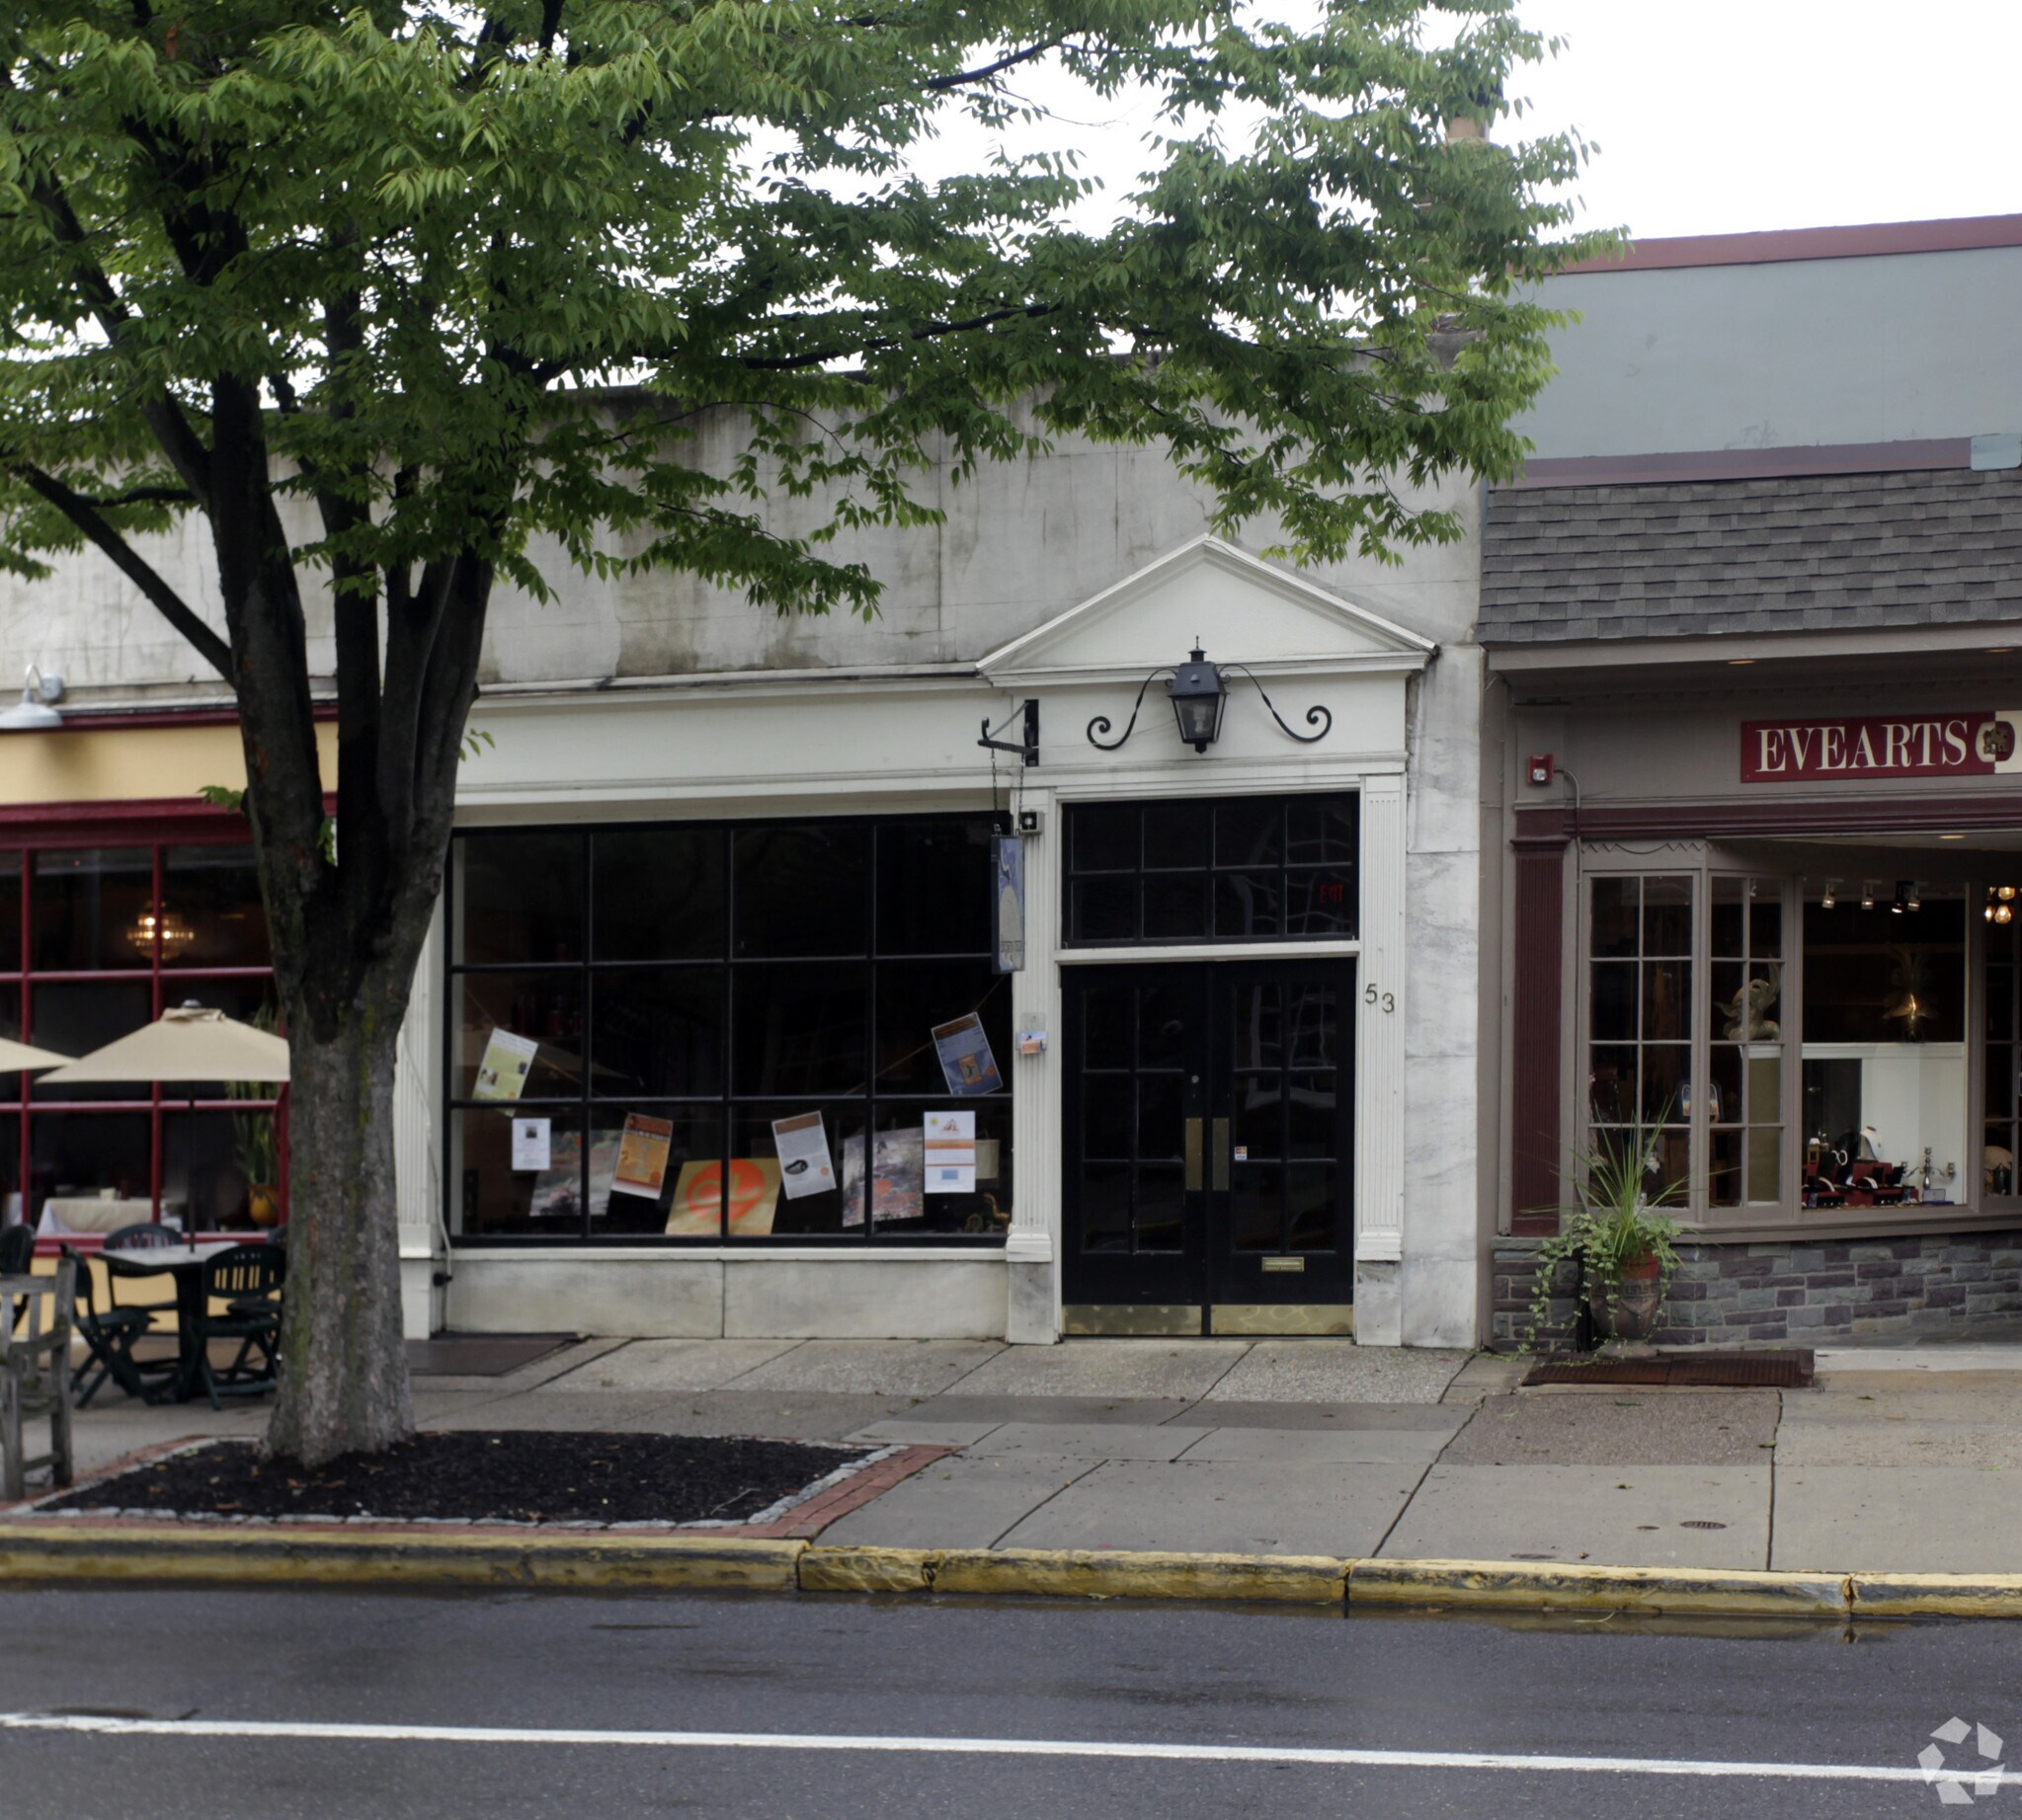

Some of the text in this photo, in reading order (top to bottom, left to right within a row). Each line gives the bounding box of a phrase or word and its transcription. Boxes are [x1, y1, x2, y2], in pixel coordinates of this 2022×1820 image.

[1754, 719, 1969, 773] EVEARTS
[1318, 883, 1344, 905] EXIT
[1365, 983, 1395, 1013] 53
